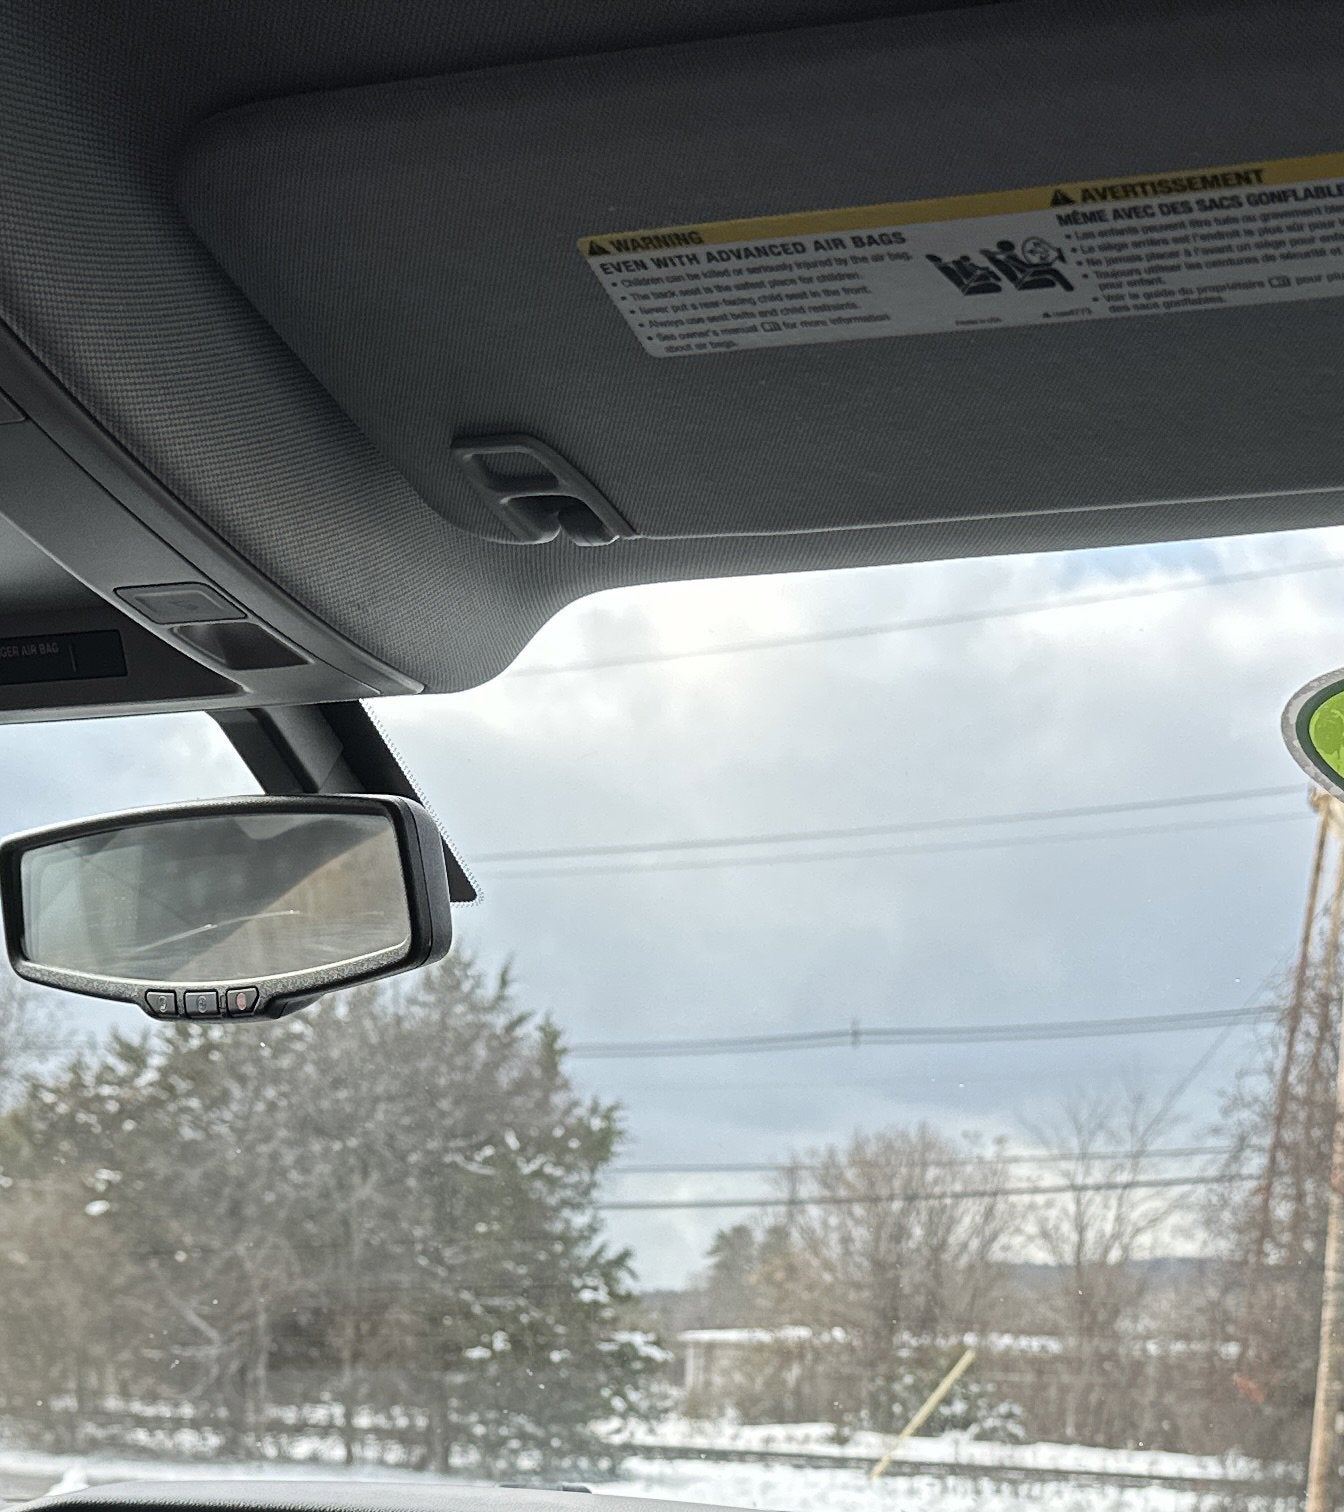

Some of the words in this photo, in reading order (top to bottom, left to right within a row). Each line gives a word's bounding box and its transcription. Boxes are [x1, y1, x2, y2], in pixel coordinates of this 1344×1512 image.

[1077, 168, 1266, 203] AVERTISSEMENT
[1054, 207, 1109, 226] MÊME
[1109, 203, 1156, 220] AVEC
[1156, 199, 1194, 216] DES
[1194, 193, 1244, 212] SACS
[599, 258, 648, 274] EVEN
[651, 253, 701, 269] WITH
[704, 241, 808, 263] ADVANCED
[811, 237, 847, 252] AIR
[850, 231, 906, 248] BAGS
[609, 230, 704, 253] WARNING
[21, 645, 37, 656] AIR
[39, 642, 59, 655] BAG
